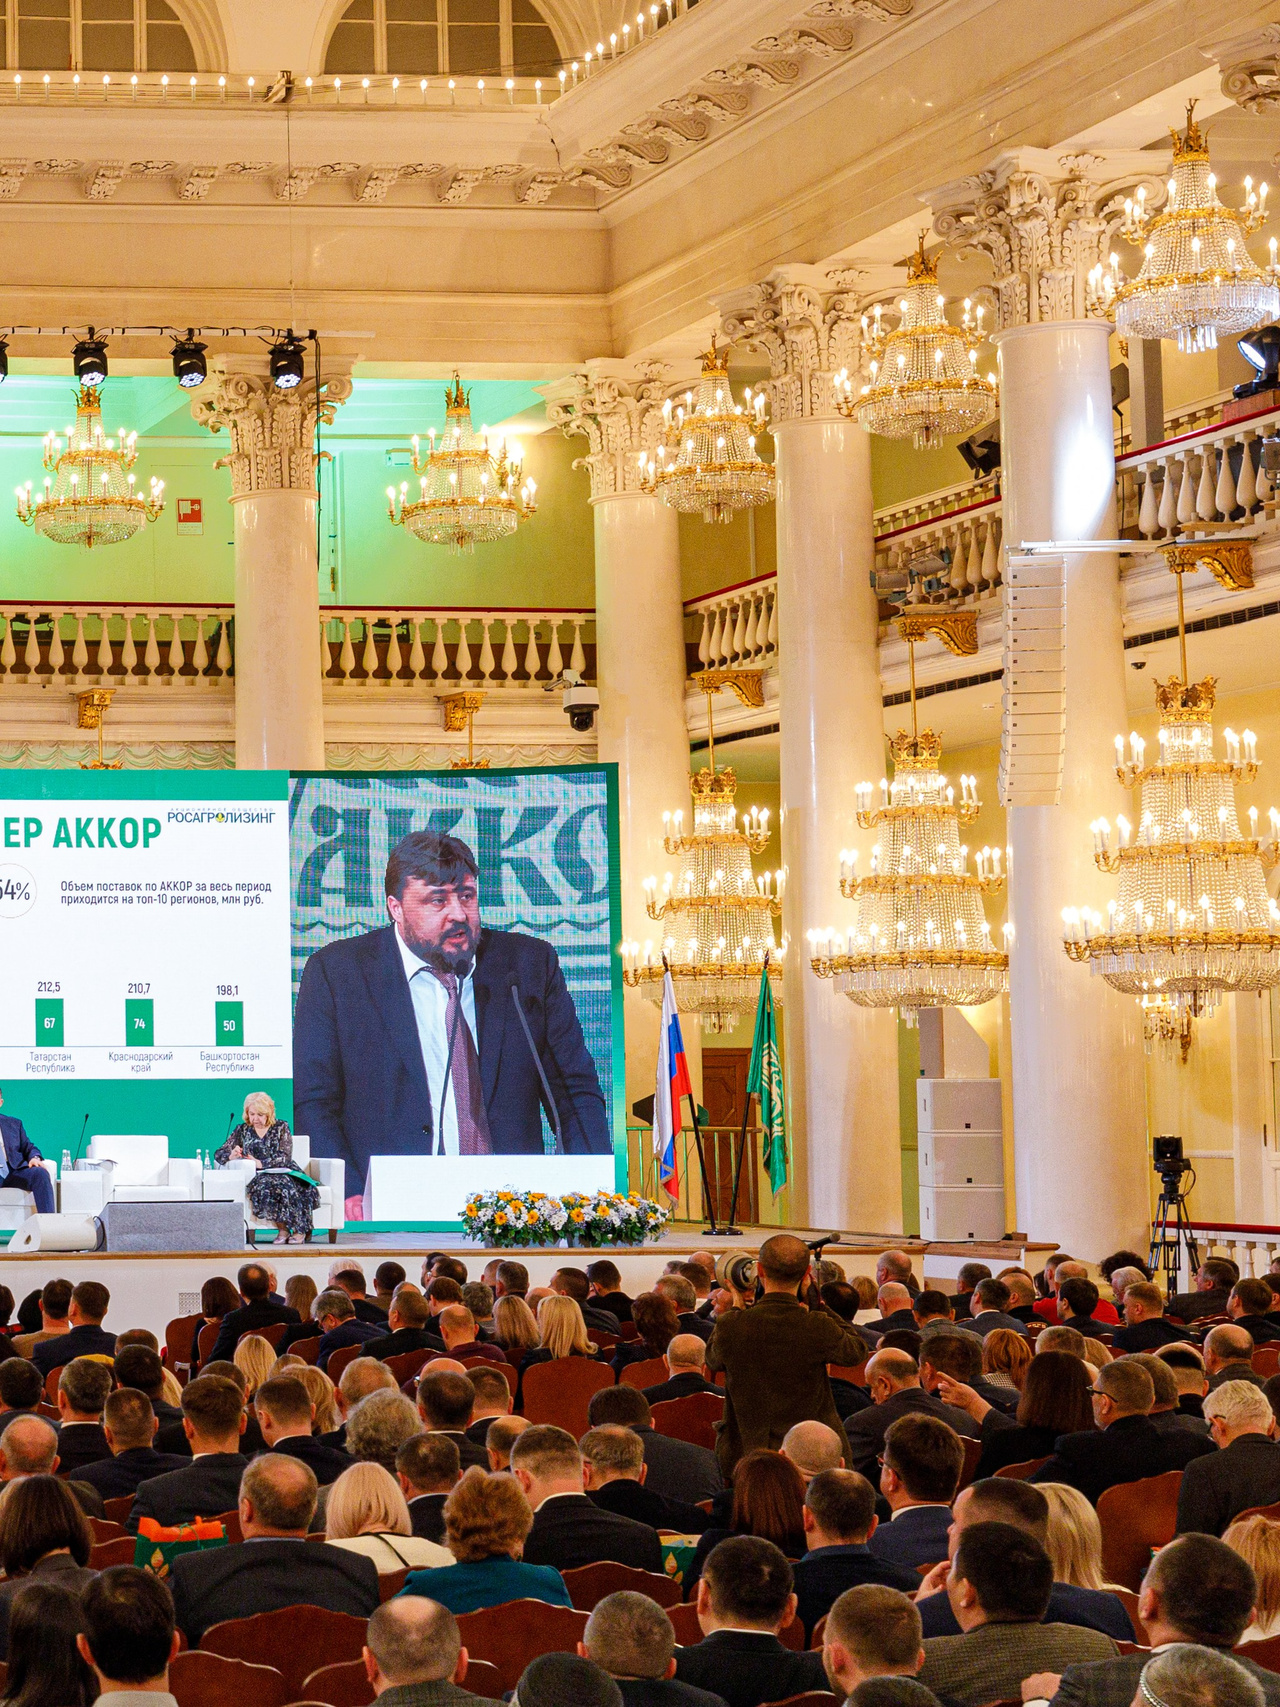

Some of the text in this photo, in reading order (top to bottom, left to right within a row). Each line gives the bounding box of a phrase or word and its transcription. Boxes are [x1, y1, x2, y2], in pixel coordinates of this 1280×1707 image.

[53, 817, 161, 848] АККОР
[61, 881, 272, 893] Объем поставок по АККОР за весь период
[62, 896, 118, 906] приходится
[122, 896, 133, 904] на
[137, 894, 167, 904] топ-10
[171, 896, 218, 906] регионов,
[244, 894, 263, 906] руб.
[38, 982, 60, 993] 212,5
[128, 983, 150, 994] 210,7
[217, 985, 238, 996] 198,1
[44, 1018, 55, 1028] 67
[134, 1019, 145, 1029] 74
[224, 1020, 235, 1031] 50
[29, 1052, 72, 1062] Татарстан
[108, 1052, 173, 1062] Краснодарский
[199, 1051, 260, 1061] Башкортостан
[25, 1063, 75, 1074] Республика
[131, 1063, 152, 1073] край
[205, 1062, 255, 1073] Республика
